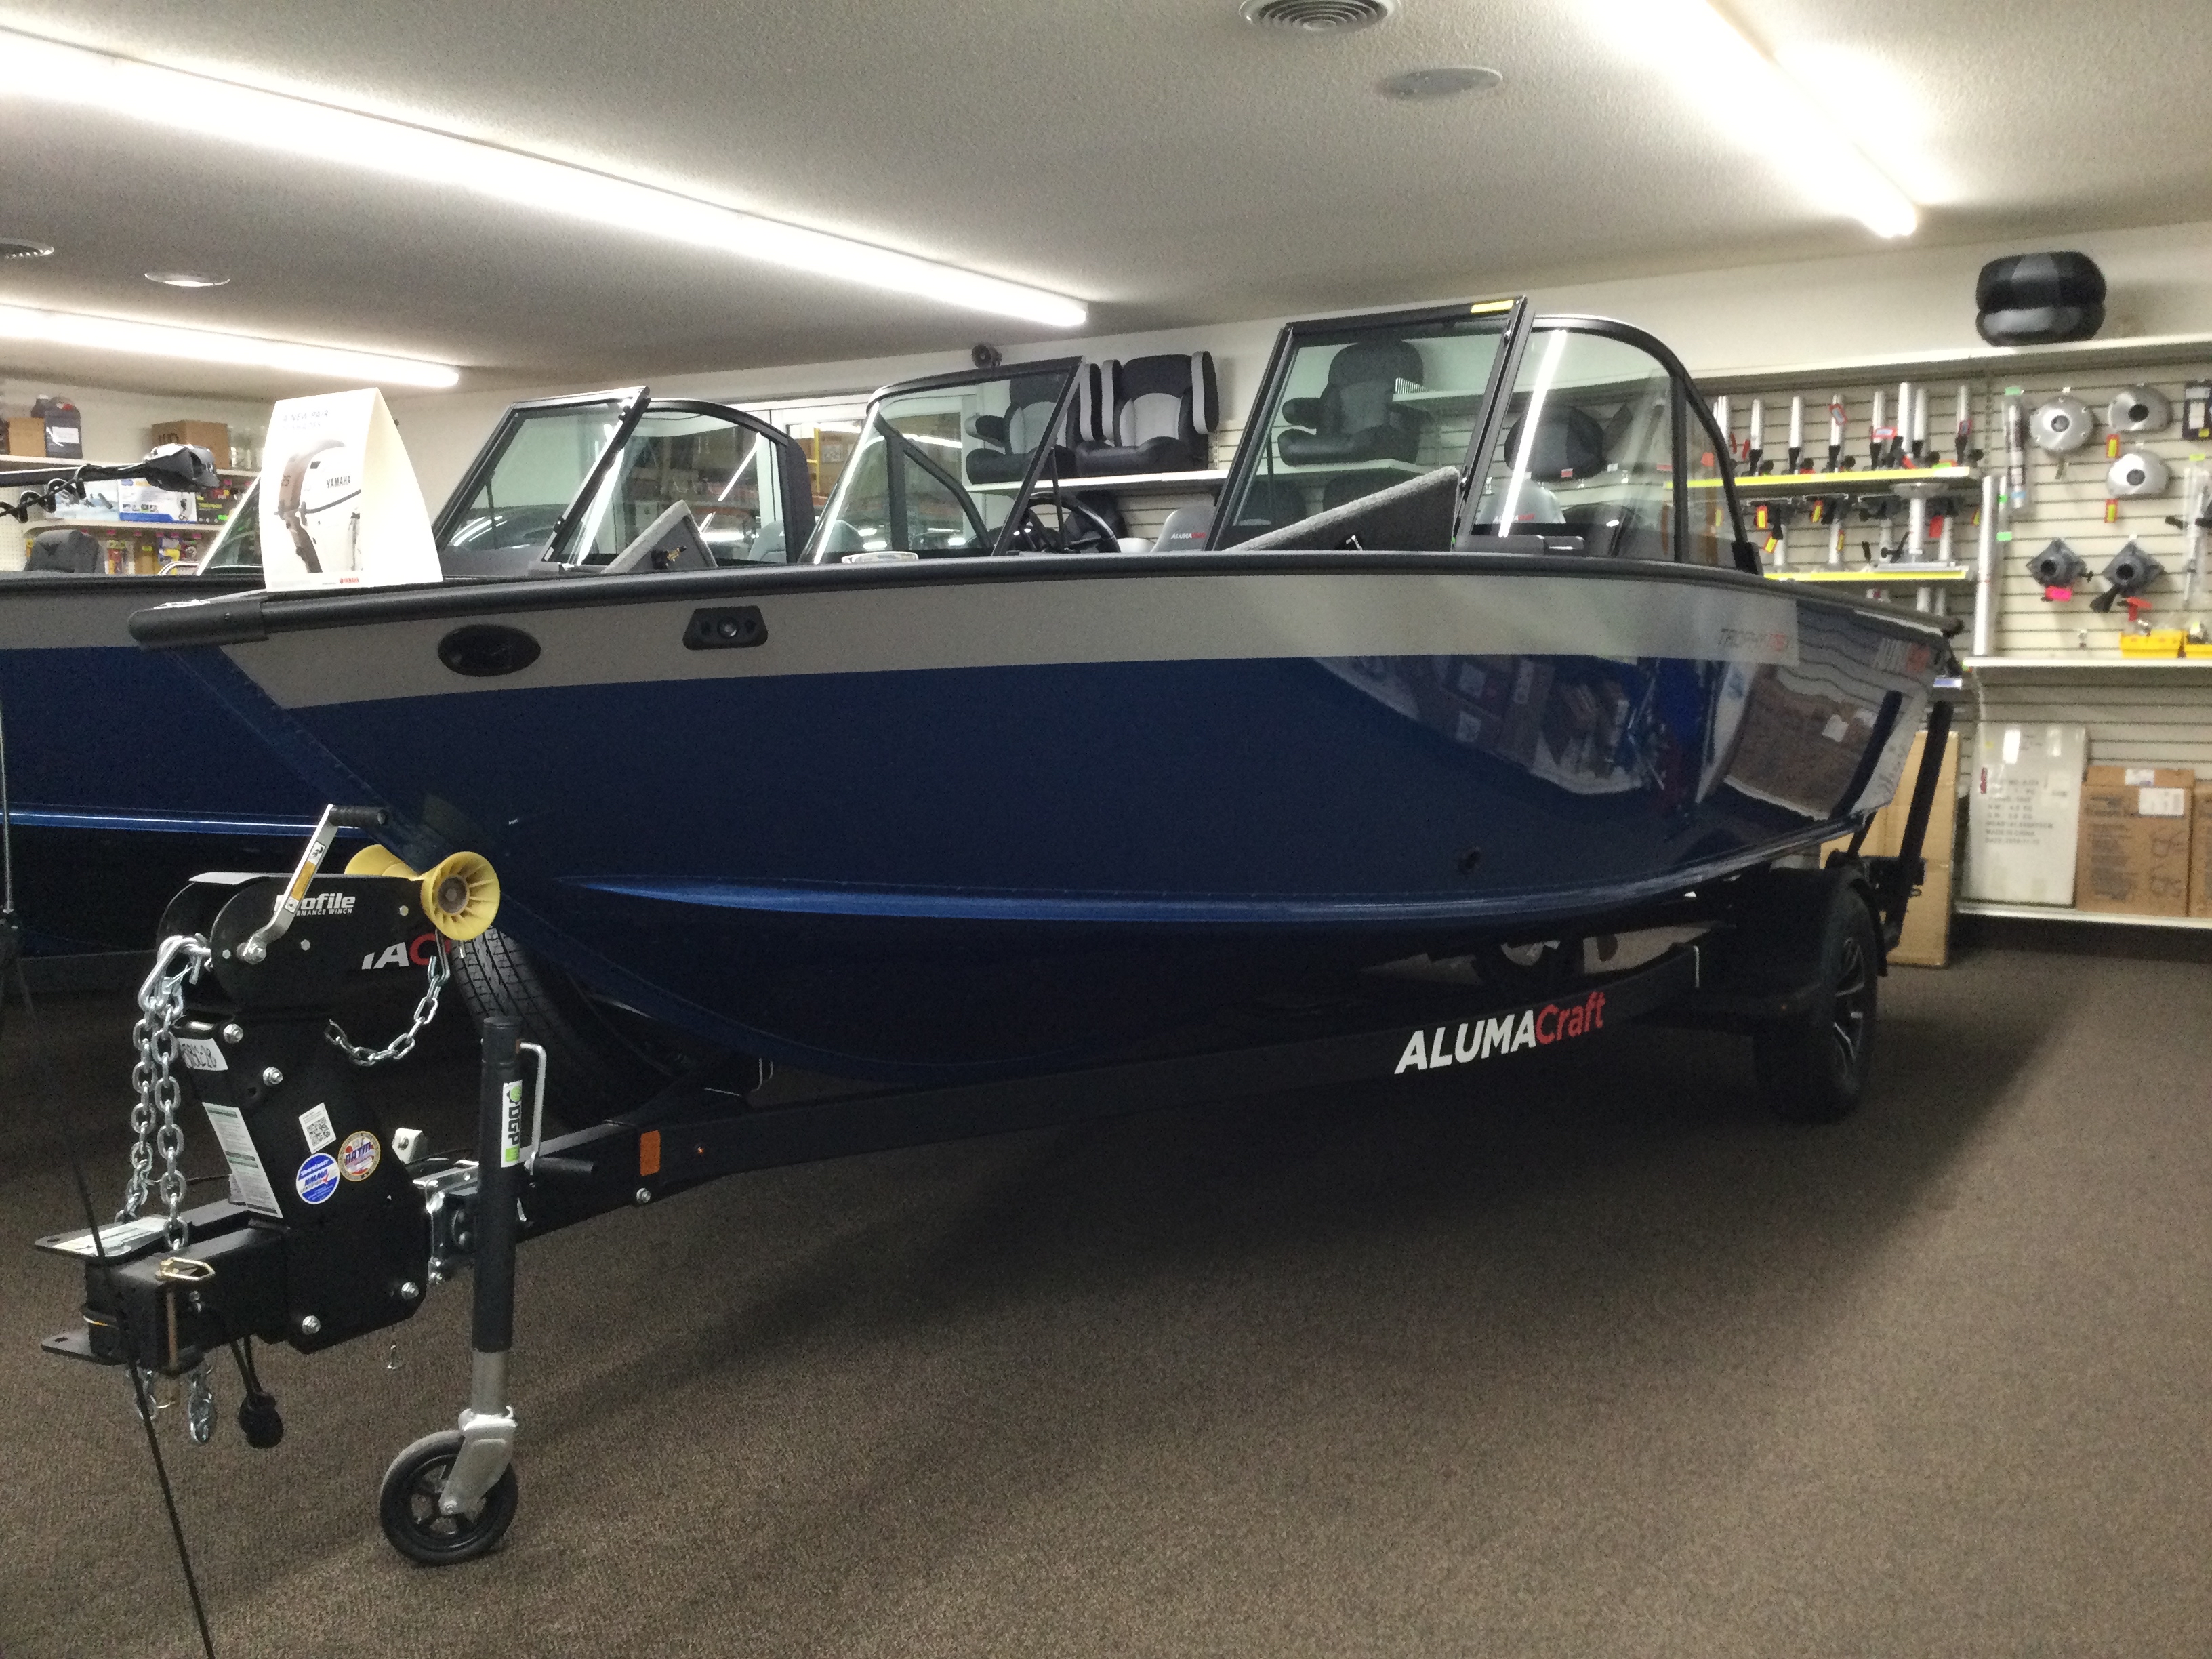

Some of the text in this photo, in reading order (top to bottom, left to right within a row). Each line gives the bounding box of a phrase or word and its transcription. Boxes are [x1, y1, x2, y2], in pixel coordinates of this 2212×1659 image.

[326, 475, 351, 489] YAMAHA
[1394, 991, 1605, 1074] ALUMACraft
[508, 1105, 521, 1145] DGP
